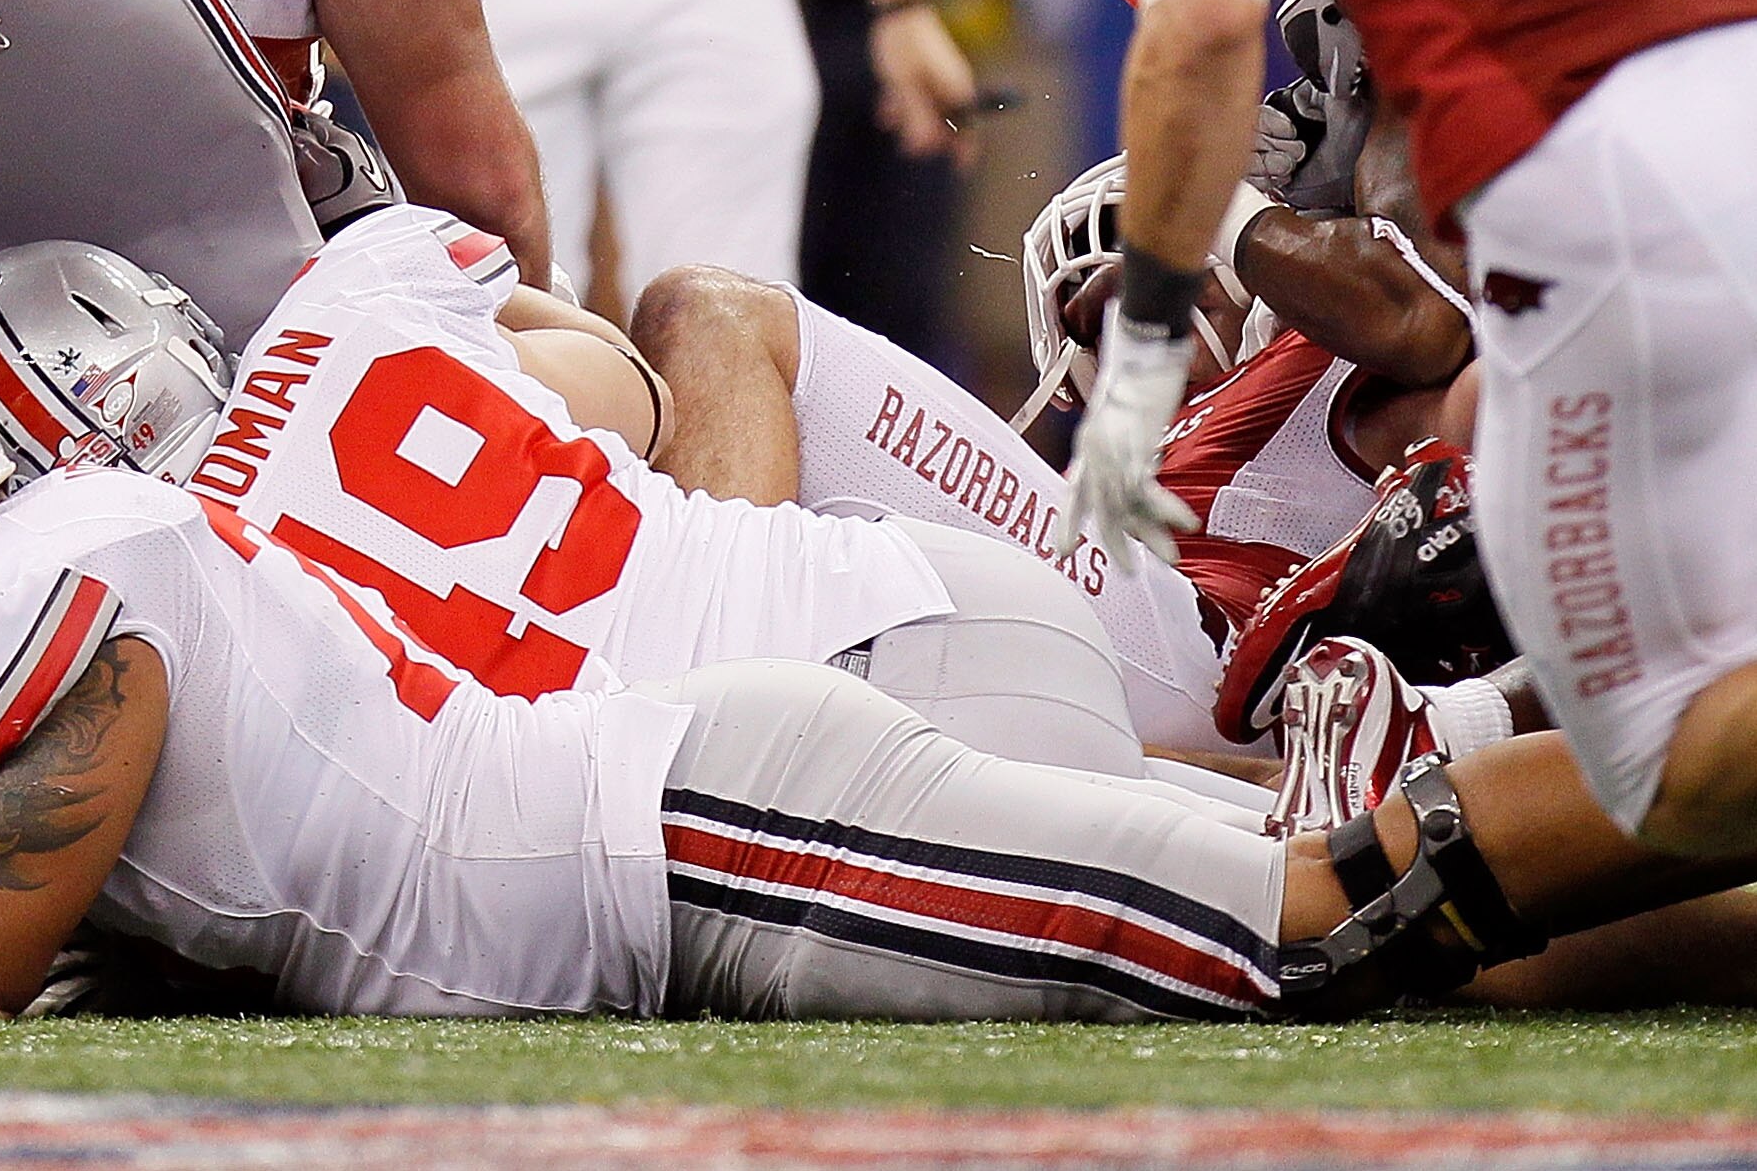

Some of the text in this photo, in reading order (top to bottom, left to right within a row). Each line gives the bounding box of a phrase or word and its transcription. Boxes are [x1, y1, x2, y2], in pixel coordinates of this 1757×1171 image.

[130, 422, 157, 451] 49
[187, 328, 335, 515] OMAN
[1546, 390, 1644, 698] RAZORBACKS
